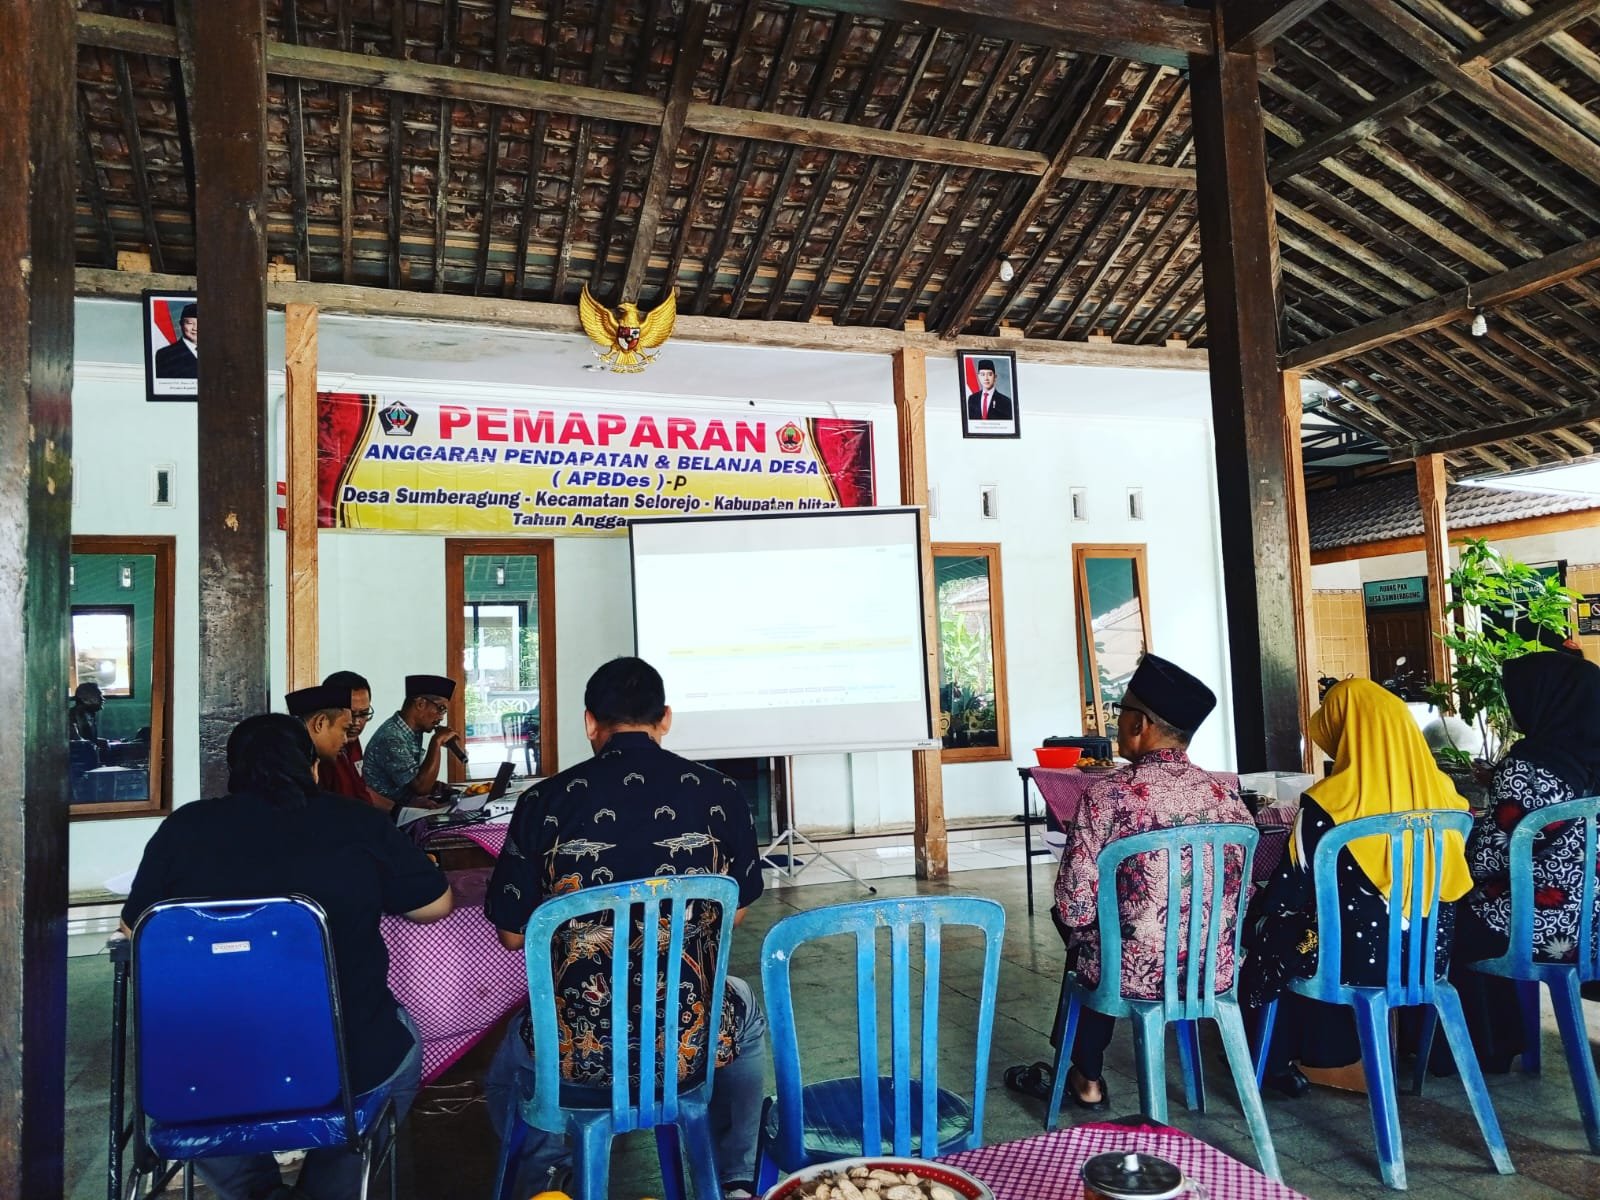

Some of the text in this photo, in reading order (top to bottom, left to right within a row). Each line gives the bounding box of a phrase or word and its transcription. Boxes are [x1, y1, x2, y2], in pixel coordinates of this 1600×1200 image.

[439, 405, 767, 454] PEMAPARAN
[364, 444, 819, 475] ANGGARAN PENDAPATAN & BELANJA DESA
[567, 471, 651, 488] APBDes
[343, 487, 390, 503] Desa
[395, 488, 521, 509] Sumberagung
[535, 491, 629, 508] Kecamatan
[634, 494, 701, 512] Selorejo
[513, 513, 630, 530] Tahun Angga
